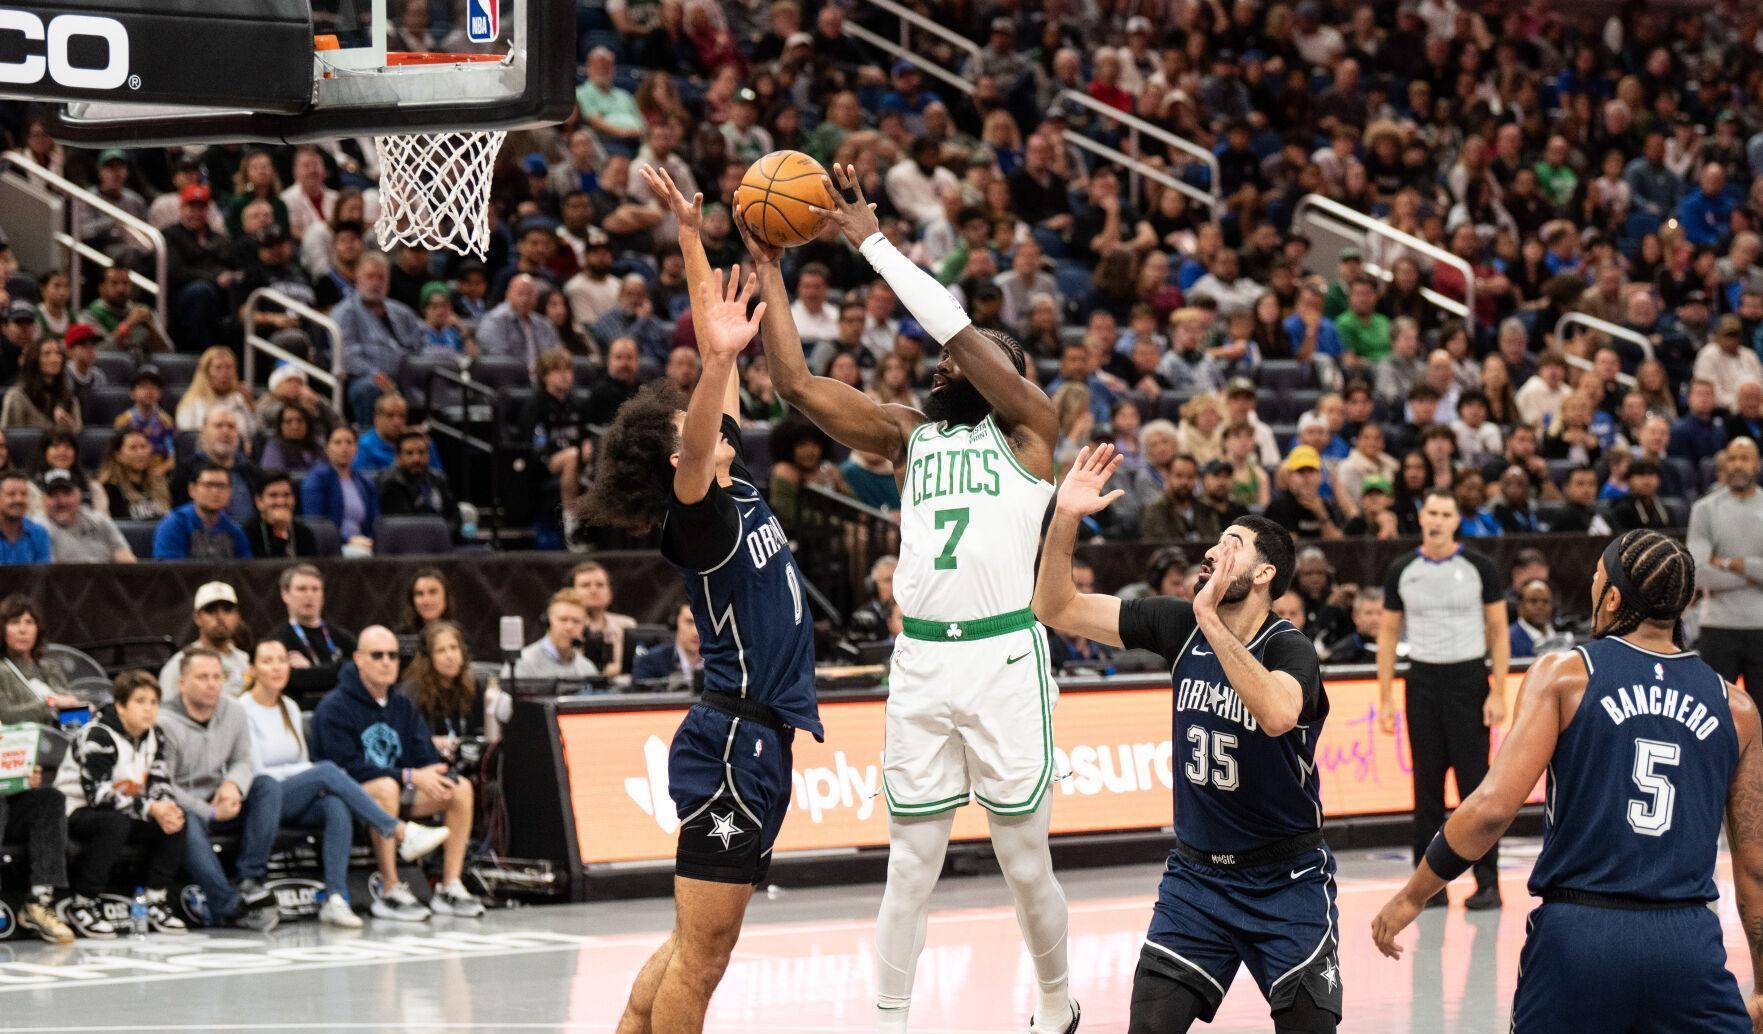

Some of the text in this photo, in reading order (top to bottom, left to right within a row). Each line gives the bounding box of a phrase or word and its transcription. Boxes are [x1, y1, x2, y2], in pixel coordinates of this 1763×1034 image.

[471, 16, 488, 35] NBA
[912, 448, 1000, 507] CELTICS
[934, 507, 970, 570] 7
[1600, 684, 1720, 741] BANCHERO
[1185, 724, 1240, 792] 35
[1626, 737, 1682, 837] 5
